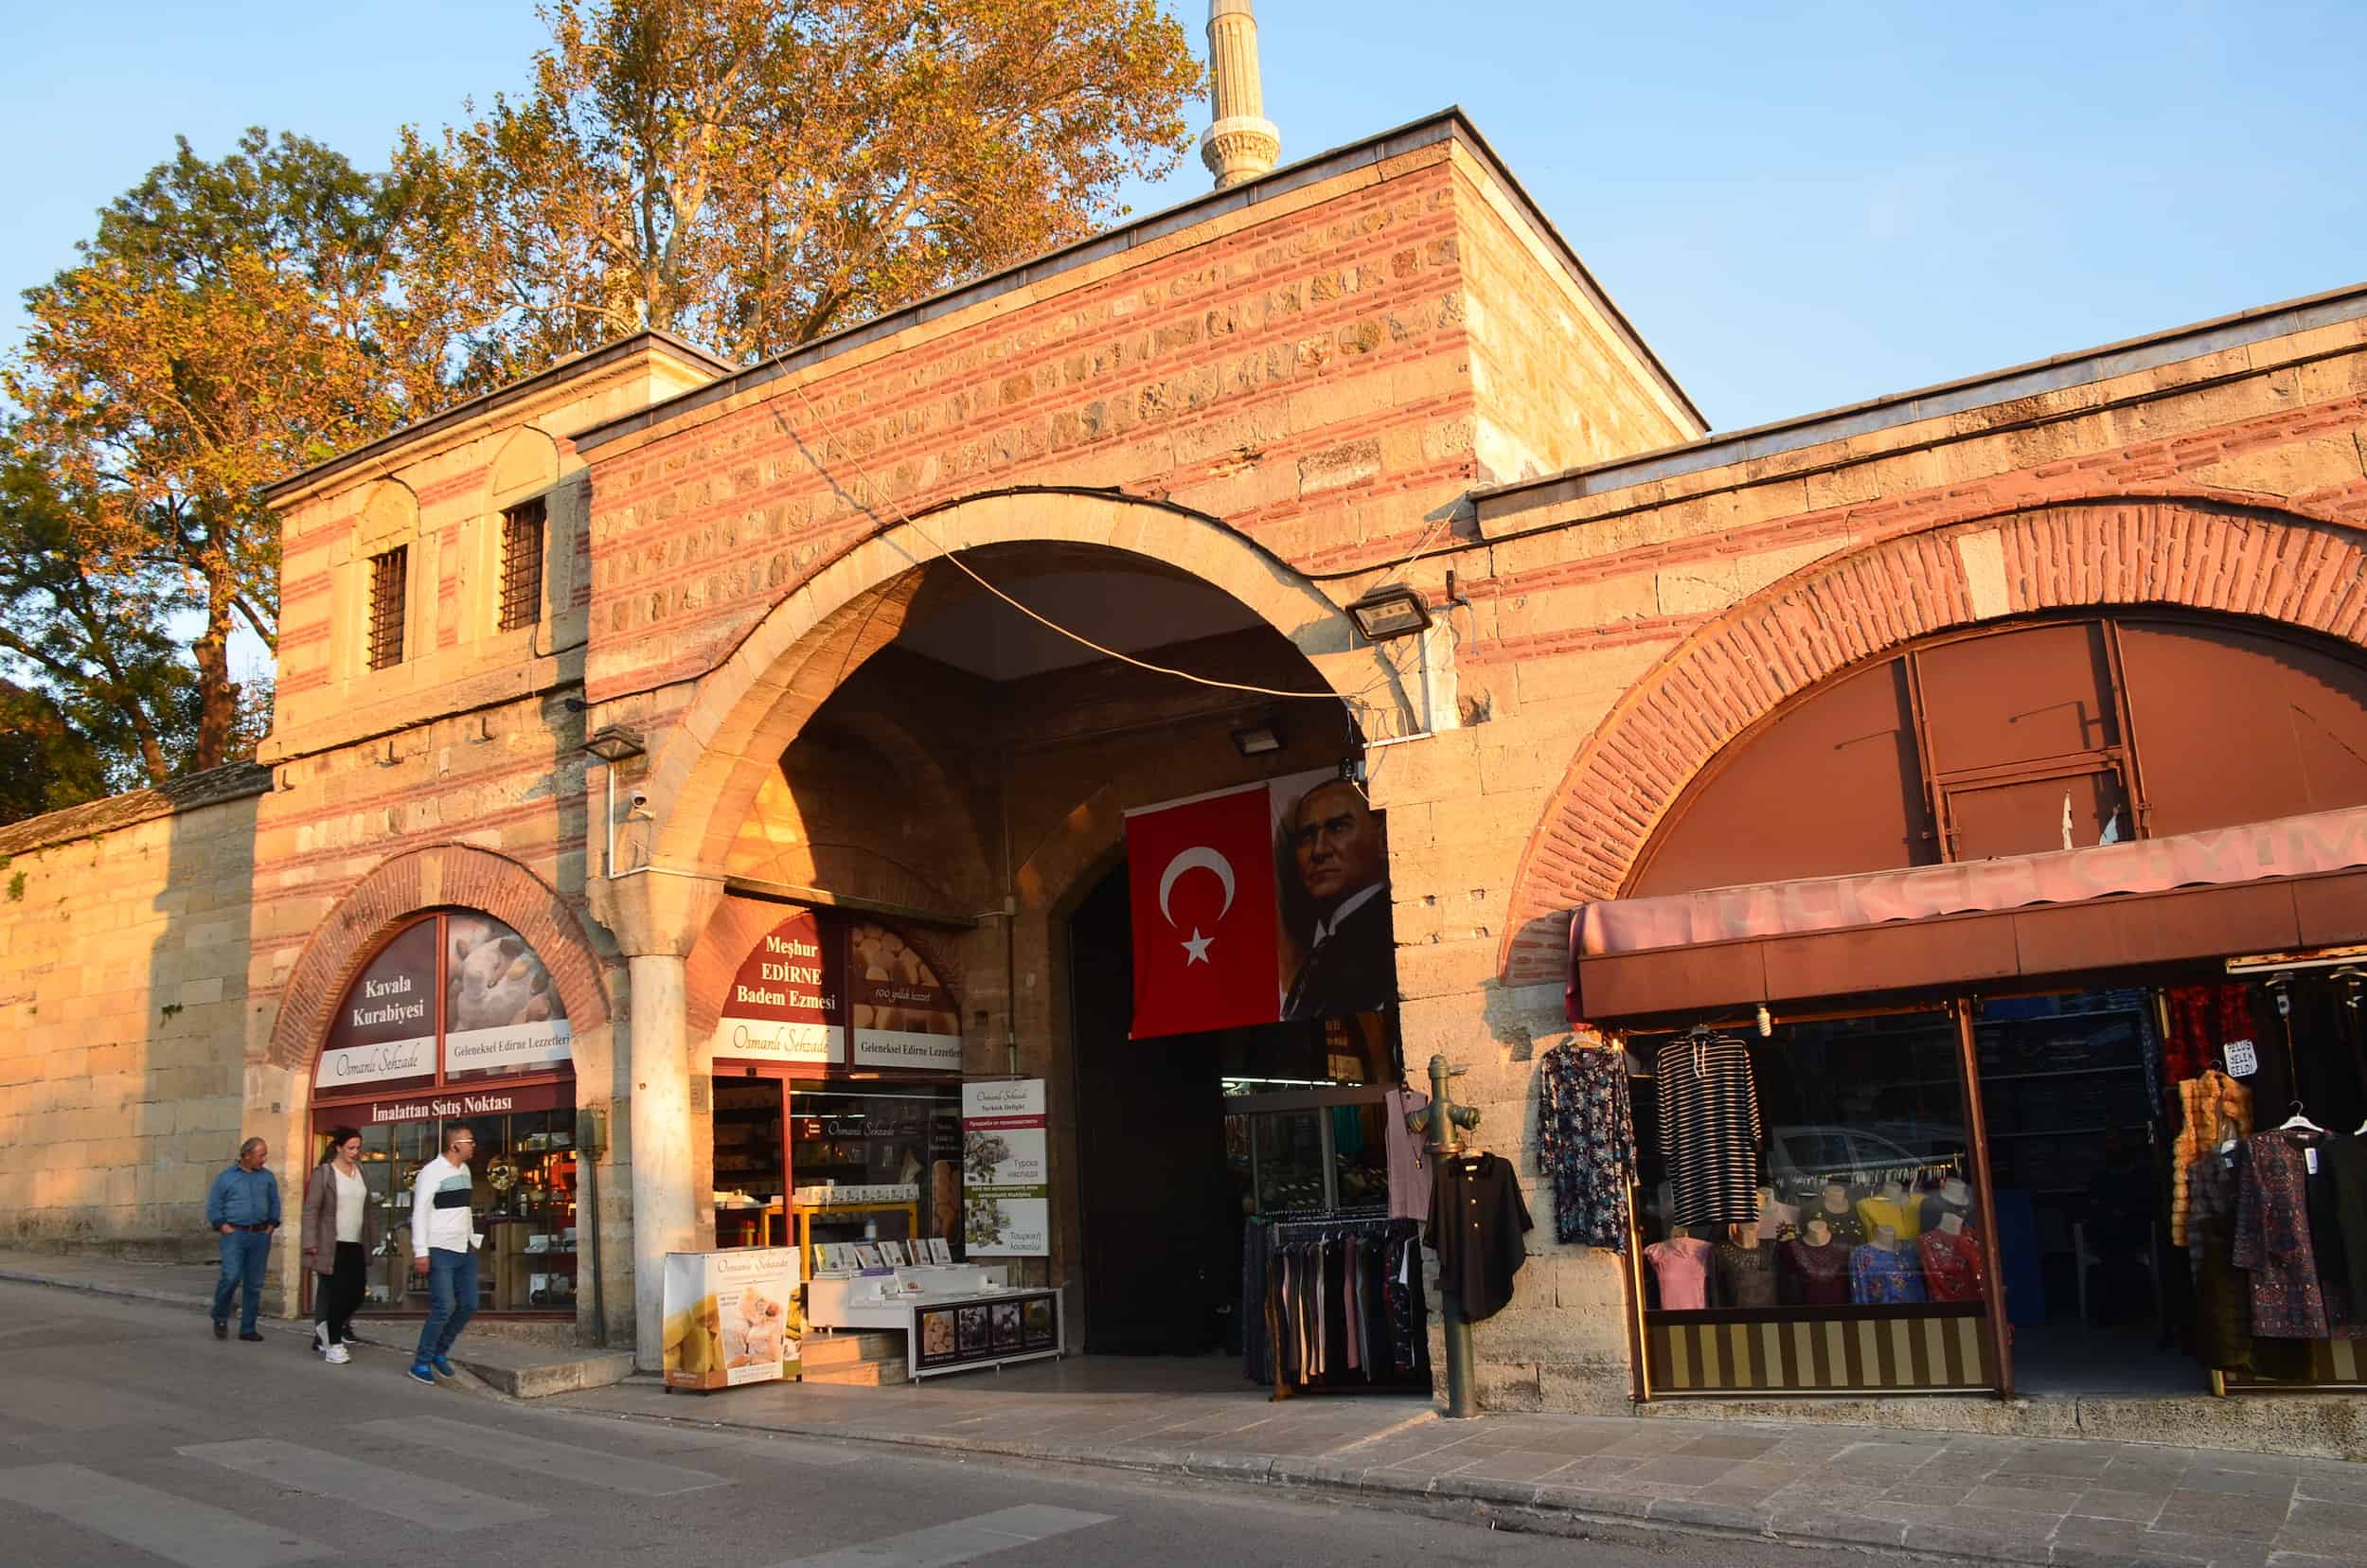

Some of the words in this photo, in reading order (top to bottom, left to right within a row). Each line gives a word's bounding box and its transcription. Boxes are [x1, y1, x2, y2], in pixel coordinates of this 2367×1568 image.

[765, 935, 818, 958] Meşhur
[761, 961, 822, 986] EDİRNE
[365, 975, 411, 998] Kavala
[737, 985, 785, 1007] Badem
[789, 989, 836, 1010] Ezmesi
[875, 988, 889, 998] 100
[911, 990, 932, 1001] lezzet
[352, 999, 424, 1025] Kurabiyesi
[454, 1042, 496, 1058] Geleneksel
[499, 1038, 525, 1052] Edirne
[528, 1033, 570, 1049] Lezzetleri
[861, 1041, 900, 1054] Geleneksel
[903, 1043, 927, 1057] Edirne
[372, 1102, 429, 1122] İmalattan
[432, 1099, 461, 1118] Satış
[464, 1095, 512, 1114] Noktası
